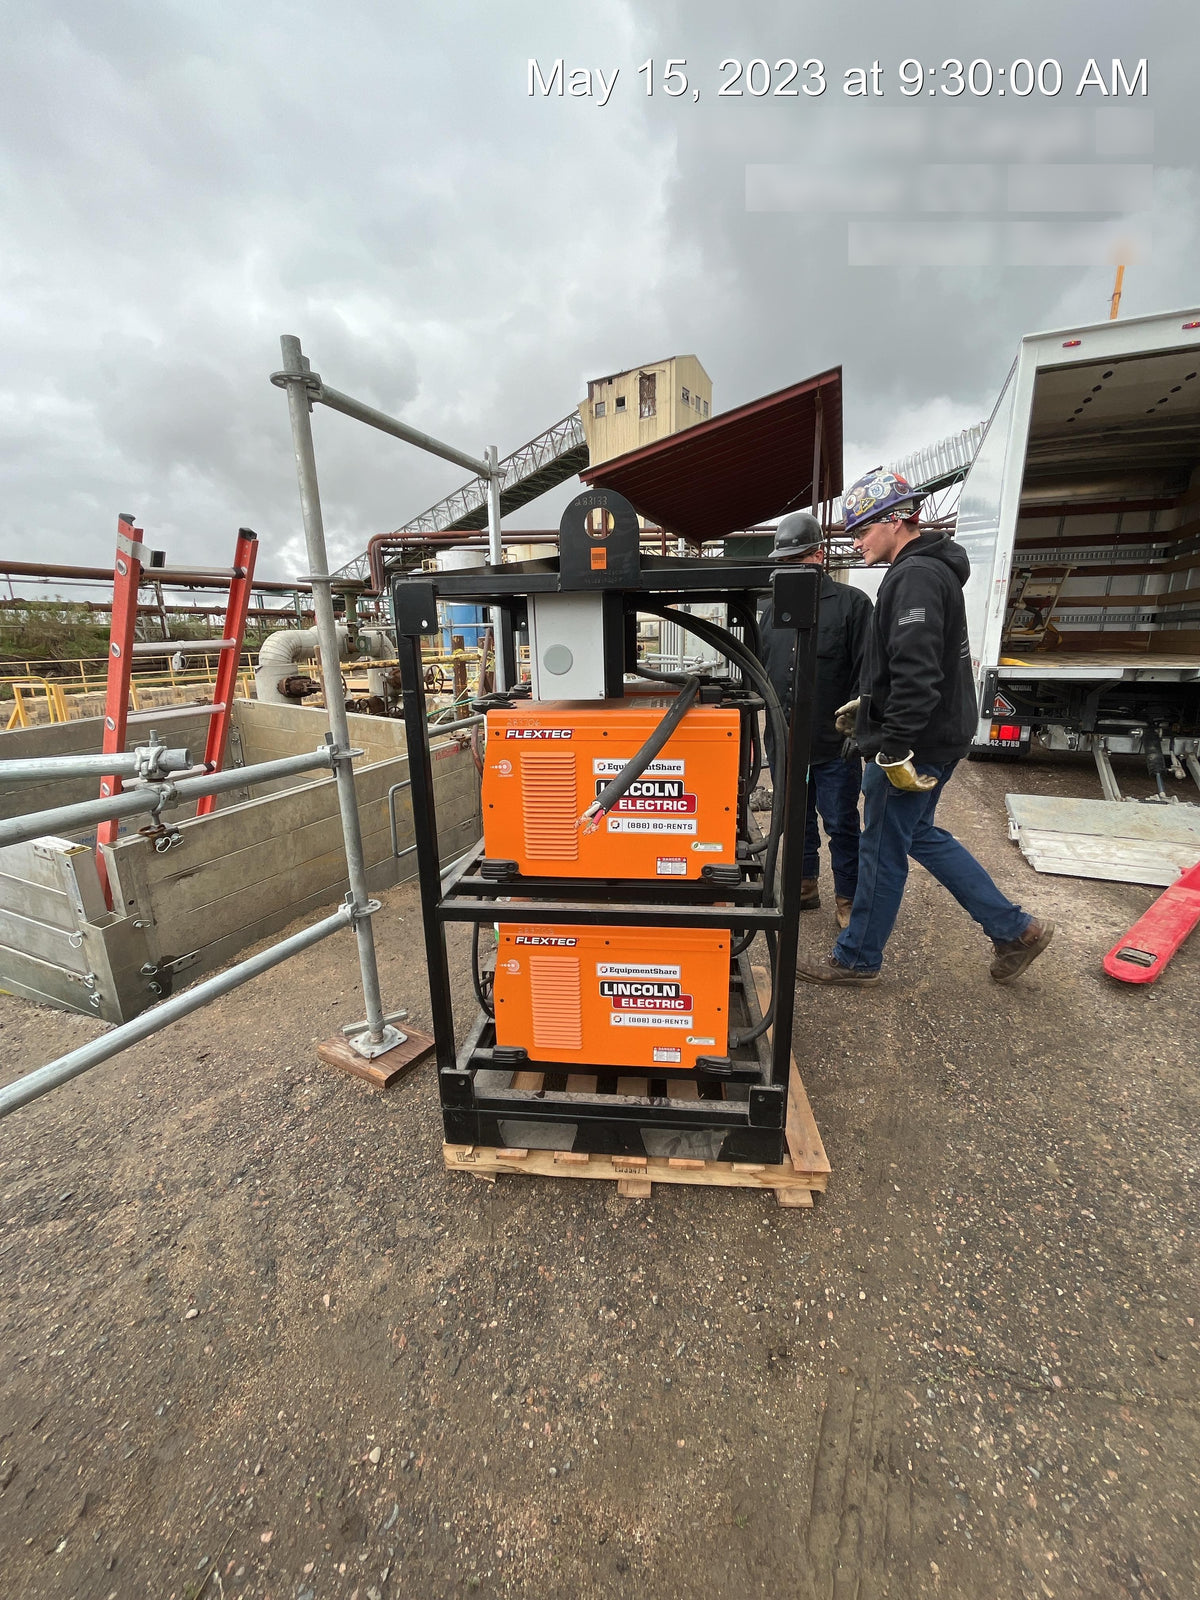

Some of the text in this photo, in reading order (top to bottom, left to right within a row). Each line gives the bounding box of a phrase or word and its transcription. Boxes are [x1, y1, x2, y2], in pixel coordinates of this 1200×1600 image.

[506, 729, 573, 739] FLEXTEC
[607, 763, 682, 772] EquintShare
[600, 782, 679, 797] LCOLN
[618, 799, 688, 811] ELECTRIC
[627, 822, 693, 831] (888) 80-RENTS
[515, 936, 577, 947] FLEXTEC
[608, 966, 678, 976] EquipmentShare
[603, 983, 676, 997] LINCOLN
[621, 998, 685, 1009] ELECTRIC
[651, 1017, 689, 1026] 80-RENTS
